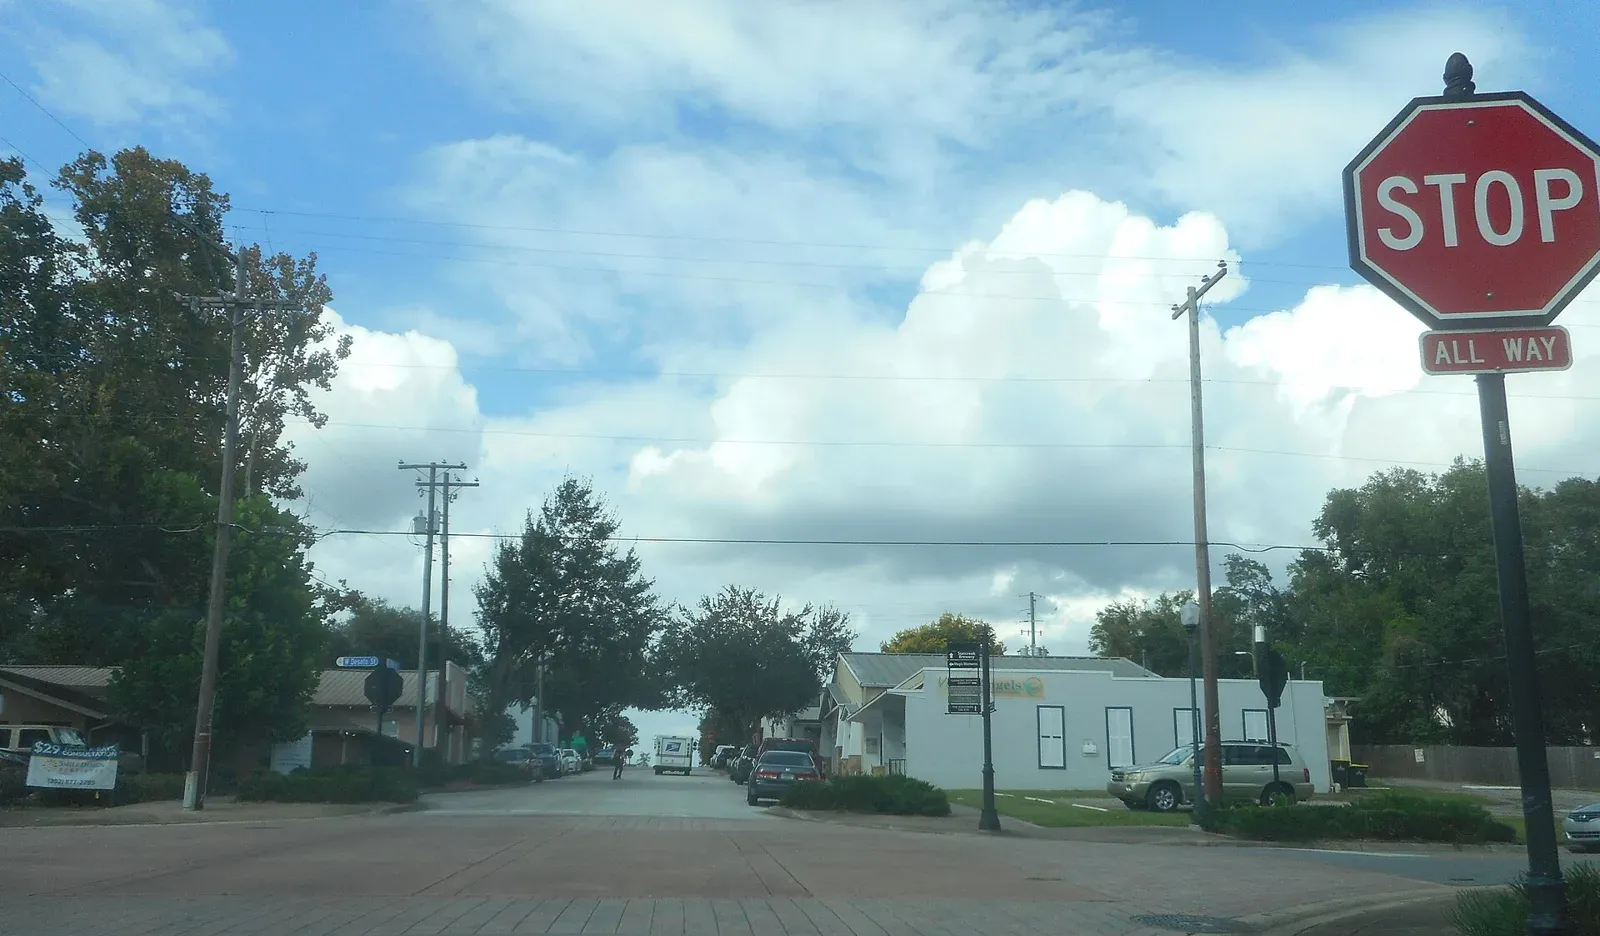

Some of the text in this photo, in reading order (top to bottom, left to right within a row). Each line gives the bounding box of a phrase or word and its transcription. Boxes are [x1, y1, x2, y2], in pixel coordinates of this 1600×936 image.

[1376, 168, 1584, 251] STOP
[1434, 336, 1557, 365] ALL WAY
[33, 740, 60, 754] $29
